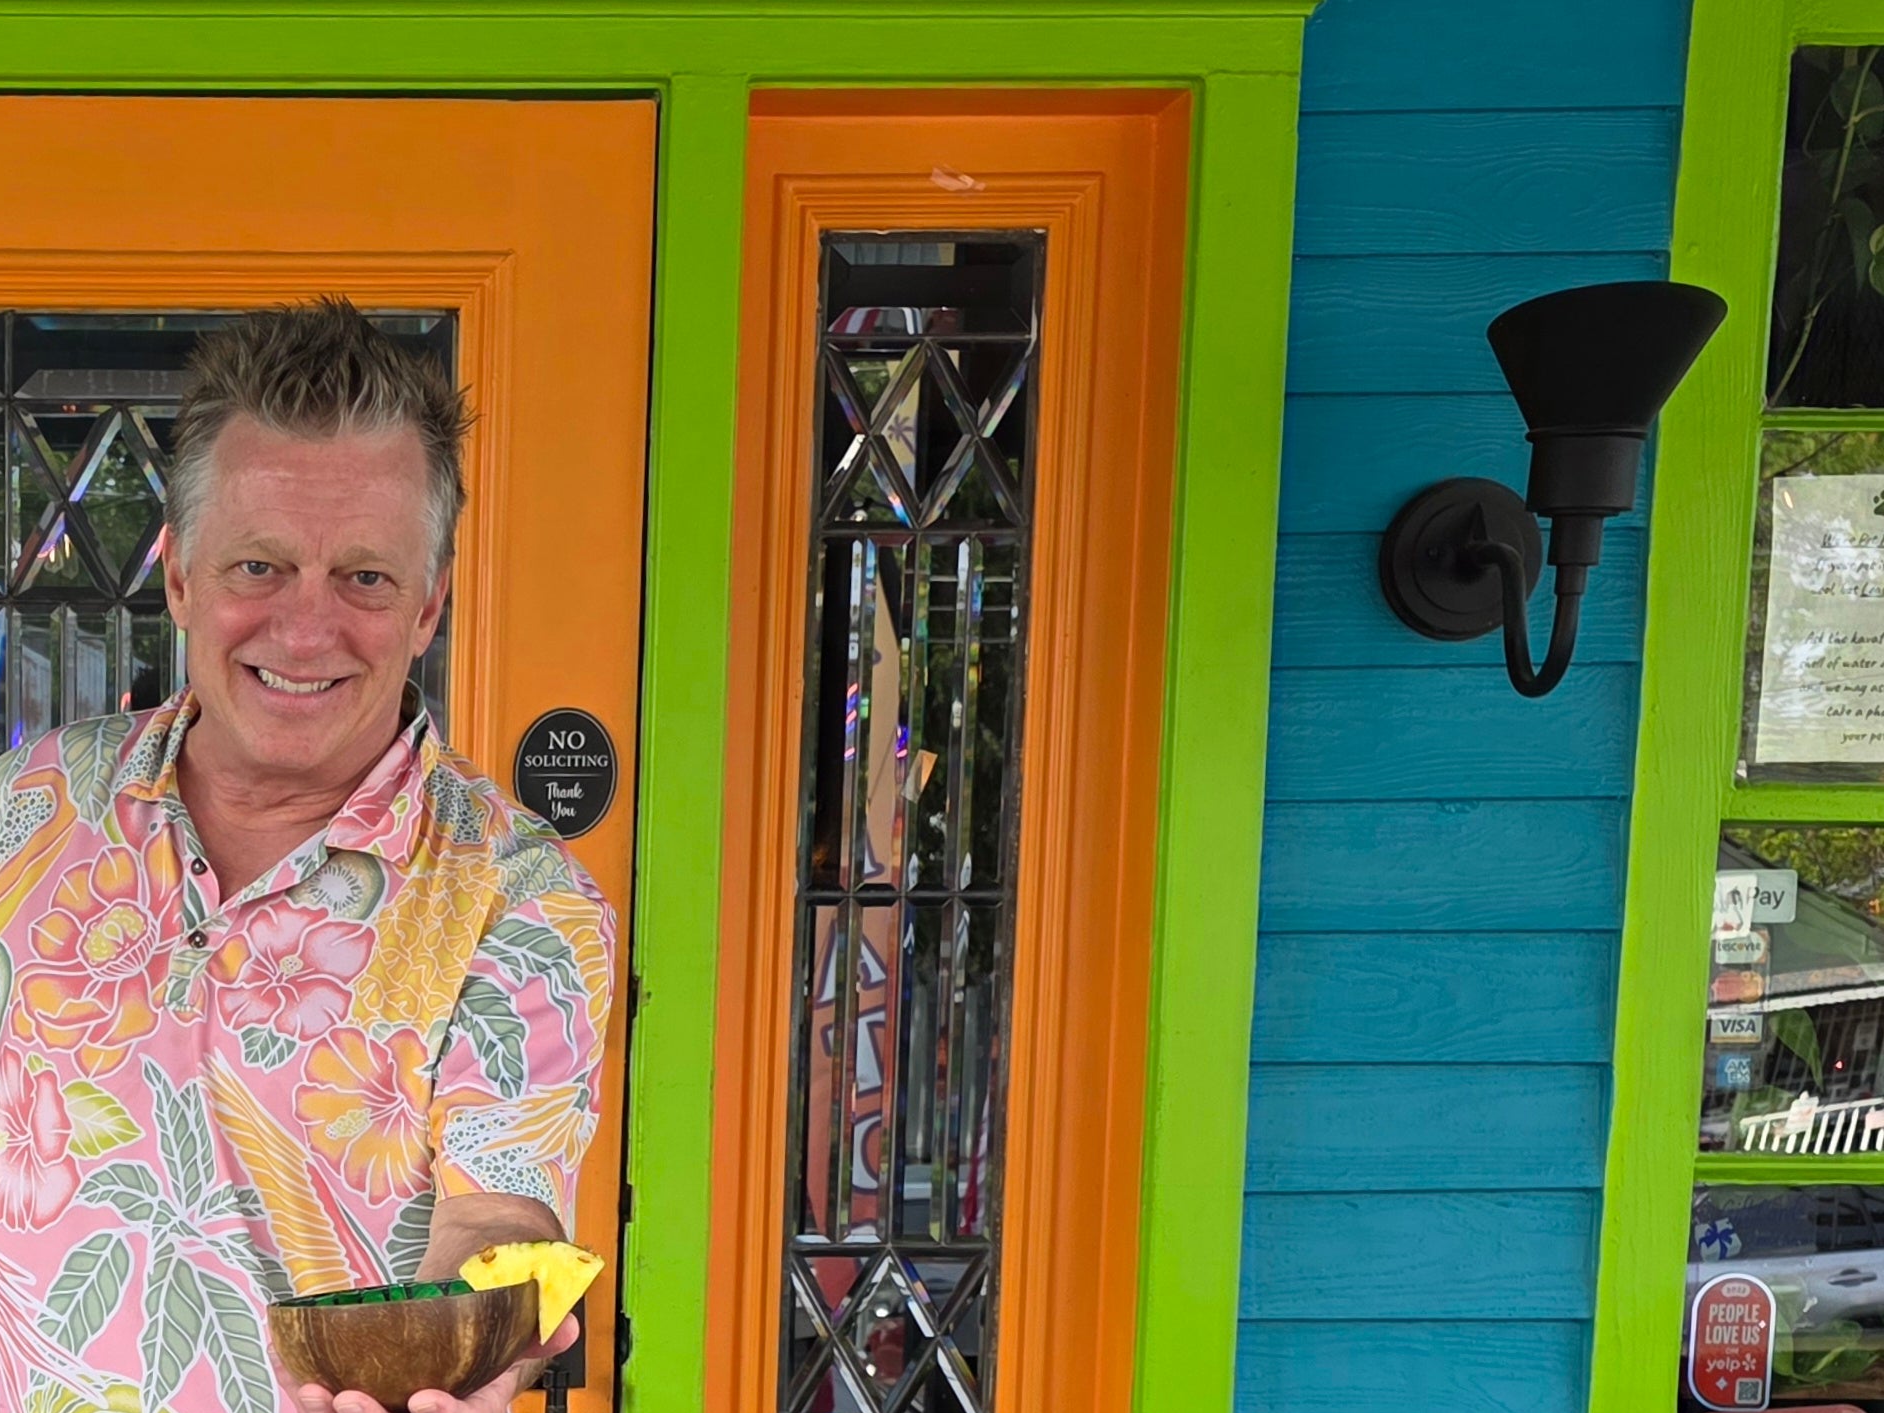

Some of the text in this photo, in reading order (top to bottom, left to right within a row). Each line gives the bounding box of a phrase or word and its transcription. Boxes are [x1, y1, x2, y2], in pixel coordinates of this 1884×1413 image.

[548, 730, 586, 750] NO
[524, 754, 609, 767] SOLICITING
[546, 781, 584, 800] Thank
[551, 801, 576, 821] You
[1720, 1018, 1756, 1033] VISA
[1709, 1303, 1761, 1324] PEOPLE
[1705, 1325, 1761, 1345] LOVE US
[1705, 1356, 1741, 1373] yelp
